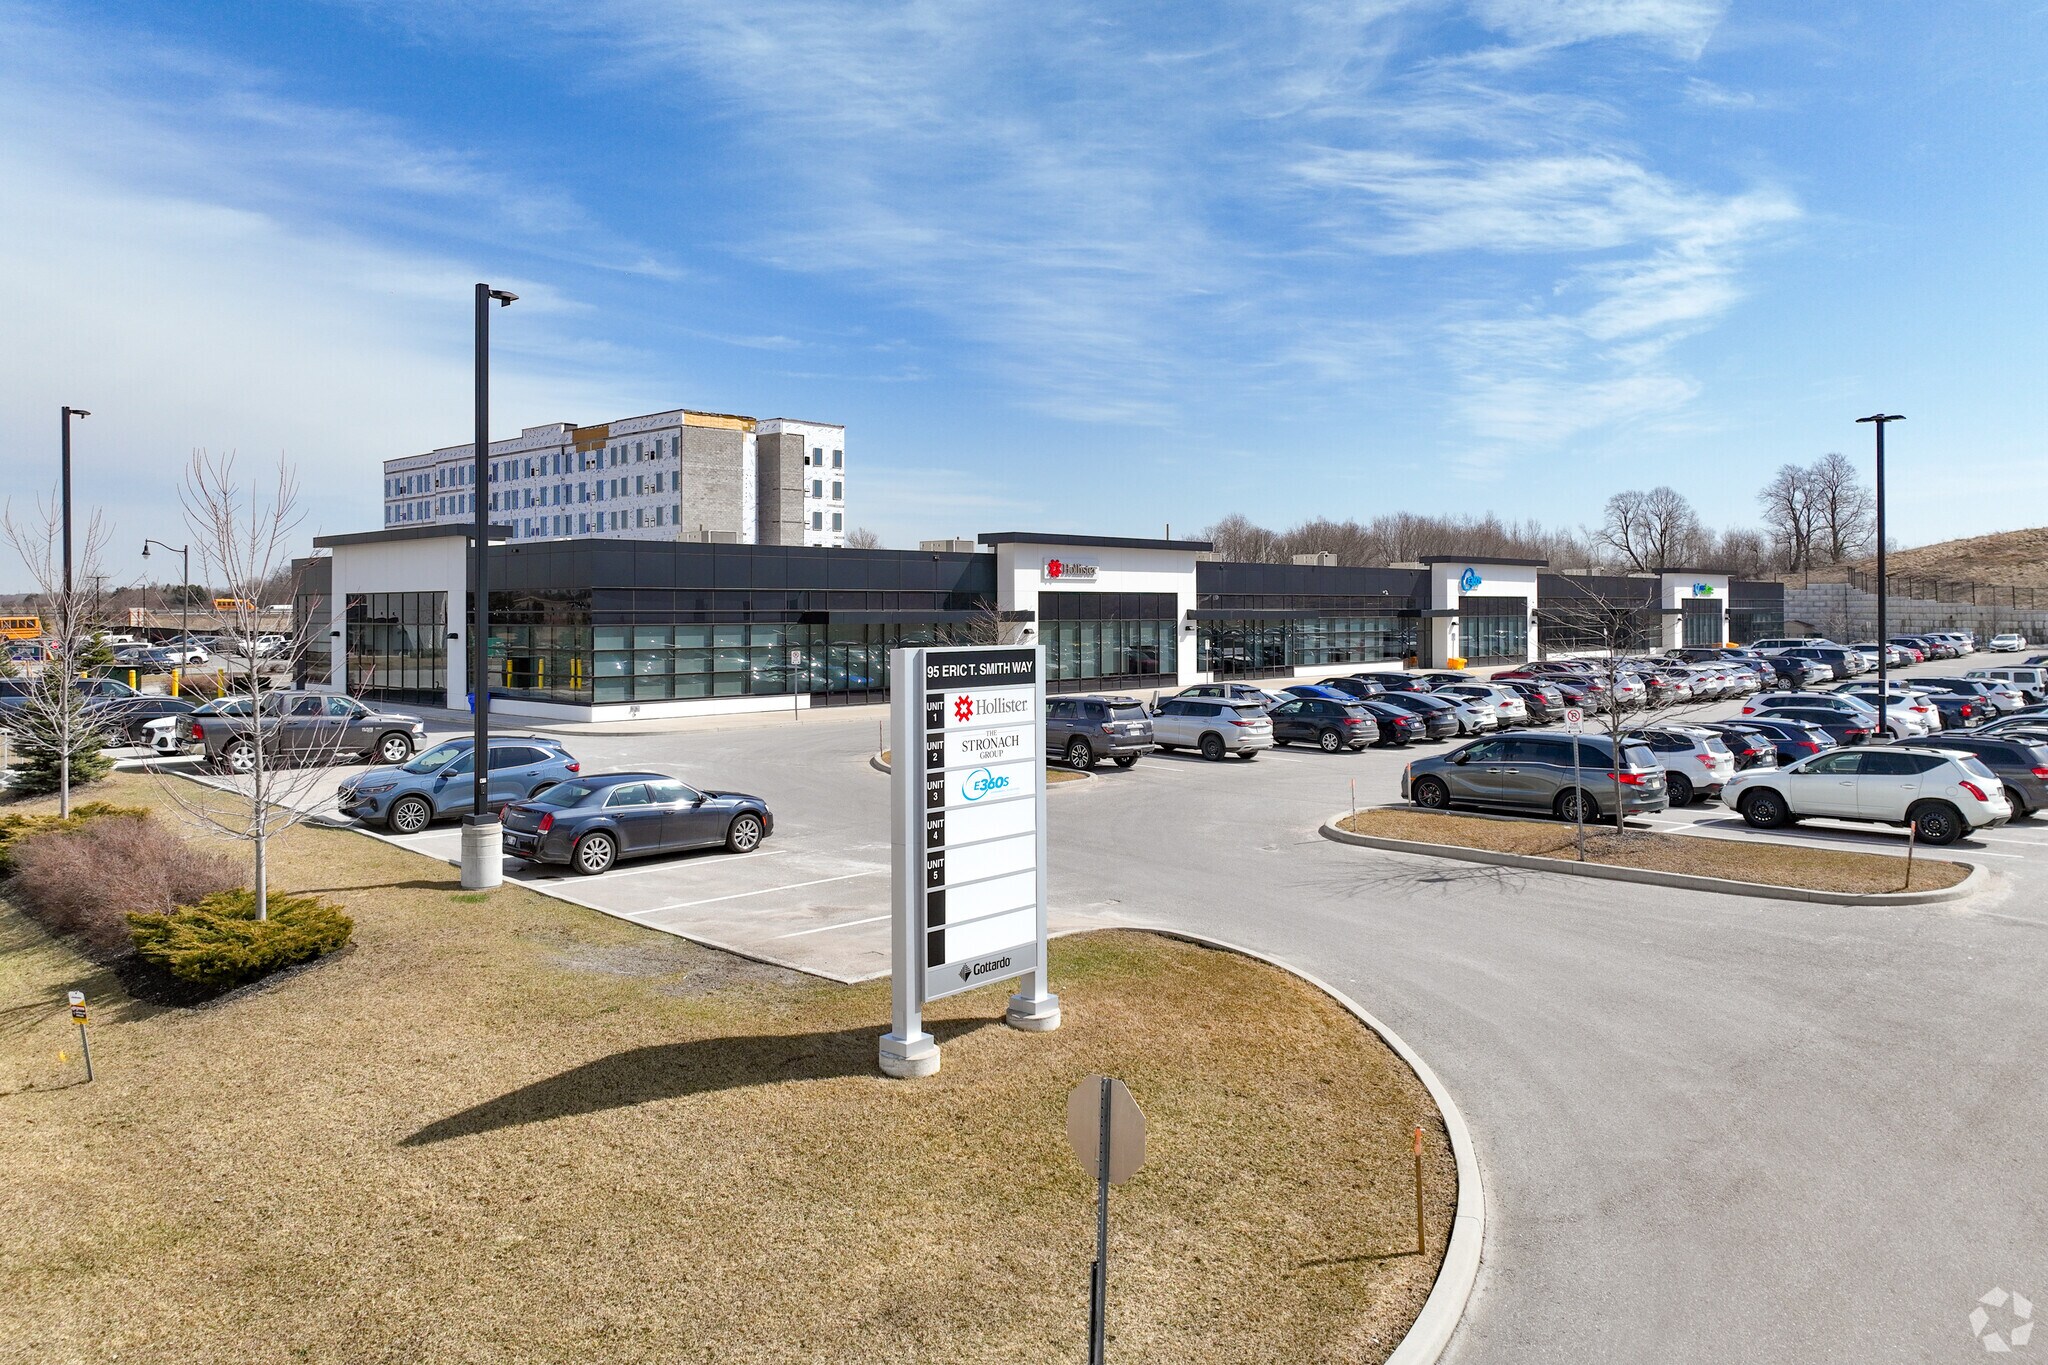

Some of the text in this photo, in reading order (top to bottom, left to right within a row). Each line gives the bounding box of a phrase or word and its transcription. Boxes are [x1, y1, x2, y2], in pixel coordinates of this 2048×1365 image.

[927, 660, 1034, 678] 95 ERIC T. SMITH WAY
[926, 701, 944, 711] UNIT
[976, 697, 1028, 716] Hollister
[933, 713, 938, 722] 1
[986, 729, 998, 737] THE
[926, 740, 944, 751] UNIT
[961, 734, 1020, 753] STRONACH
[932, 752, 938, 761] 2
[979, 749, 1004, 760] GROUP
[926, 779, 944, 790] UNIT
[973, 776, 1010, 792] E360S
[933, 792, 938, 801] 3
[926, 819, 945, 830] UNIT
[933, 831, 938, 840] 4
[926, 858, 945, 870] UNIT
[933, 871, 938, 880] 5
[973, 956, 1011, 976] Gottardo
